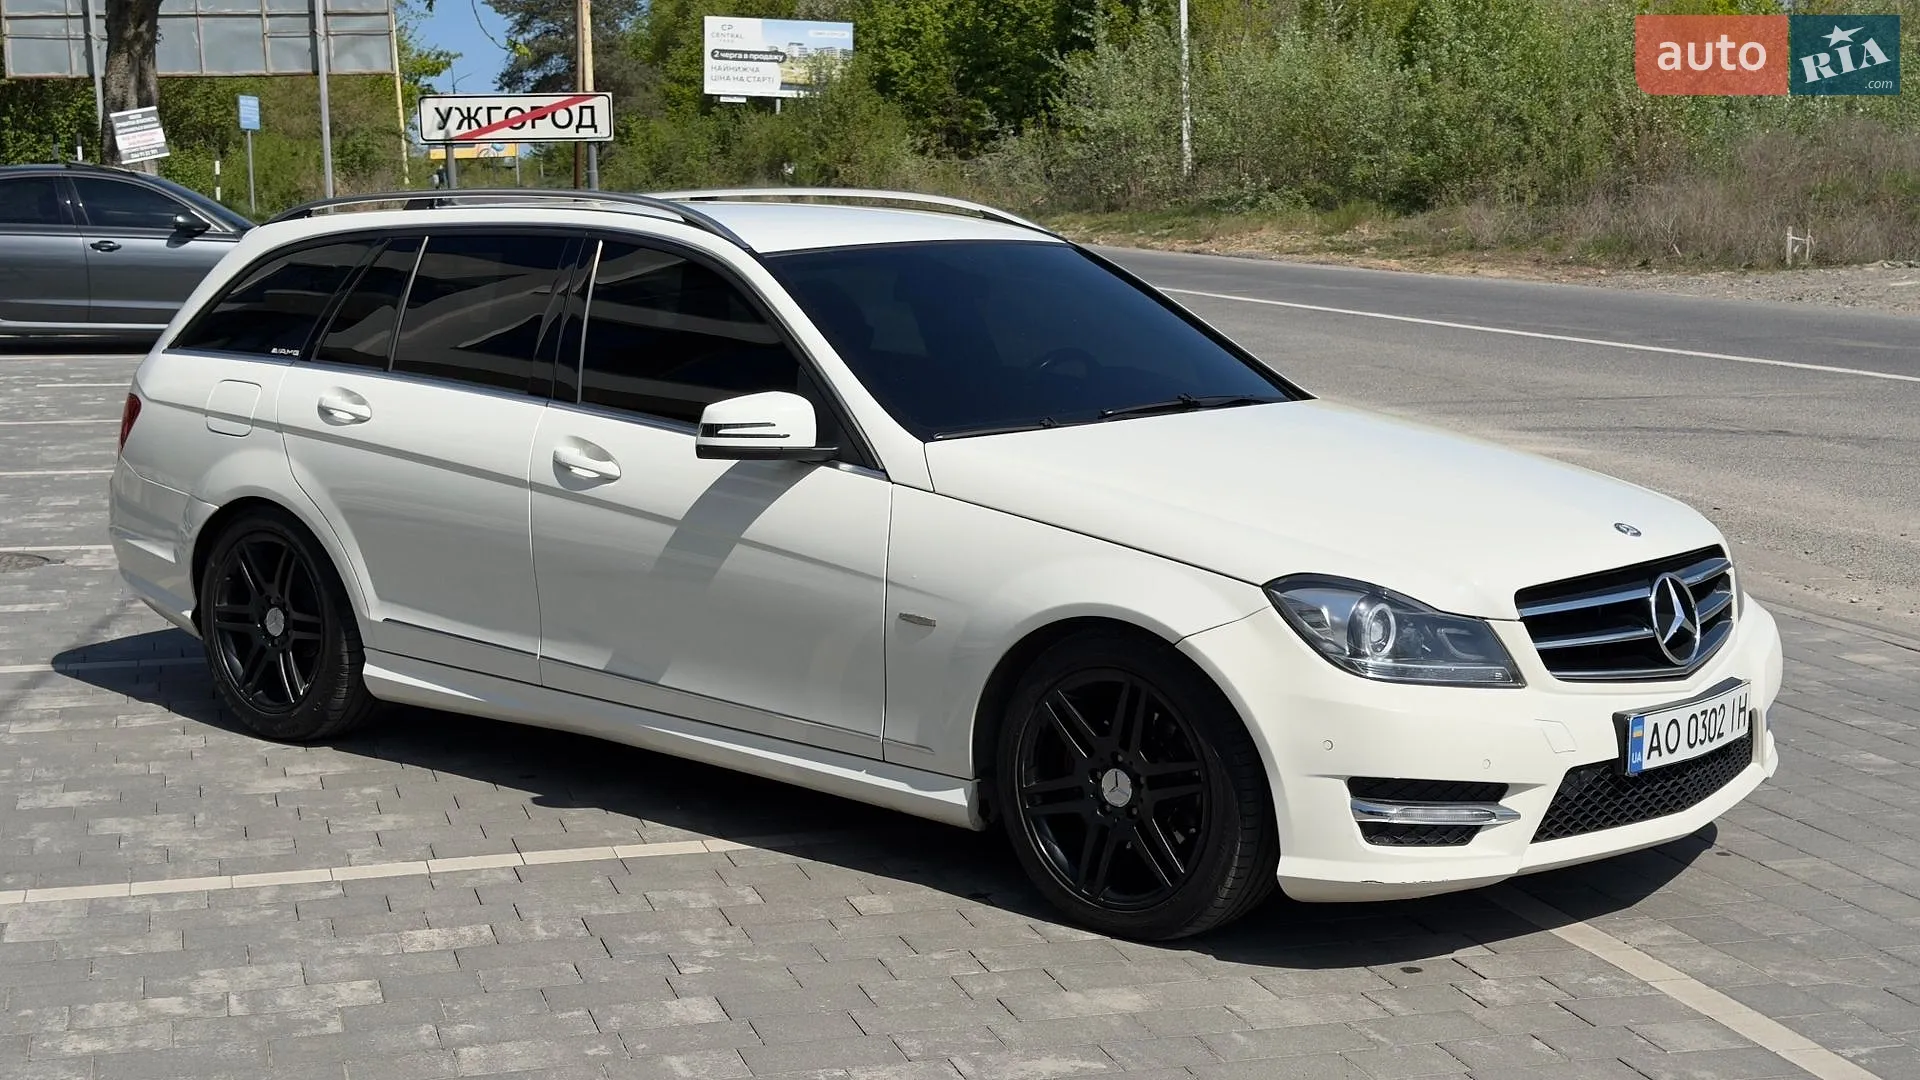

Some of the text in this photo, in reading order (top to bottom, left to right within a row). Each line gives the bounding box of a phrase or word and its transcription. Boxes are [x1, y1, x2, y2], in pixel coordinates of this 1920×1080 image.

[711, 31, 744, 39] CENTRAL
[713, 50, 720, 58] 2
[720, 51, 743, 60] черга
[749, 53, 784, 62] продажу
[746, 76, 775, 84] СТАРТІ
[434, 106, 598, 133] УЖГОРОД
[1647, 719, 1681, 760] AO
[1687, 703, 1726, 750] 0302
[1631, 752, 1642, 763] UA
